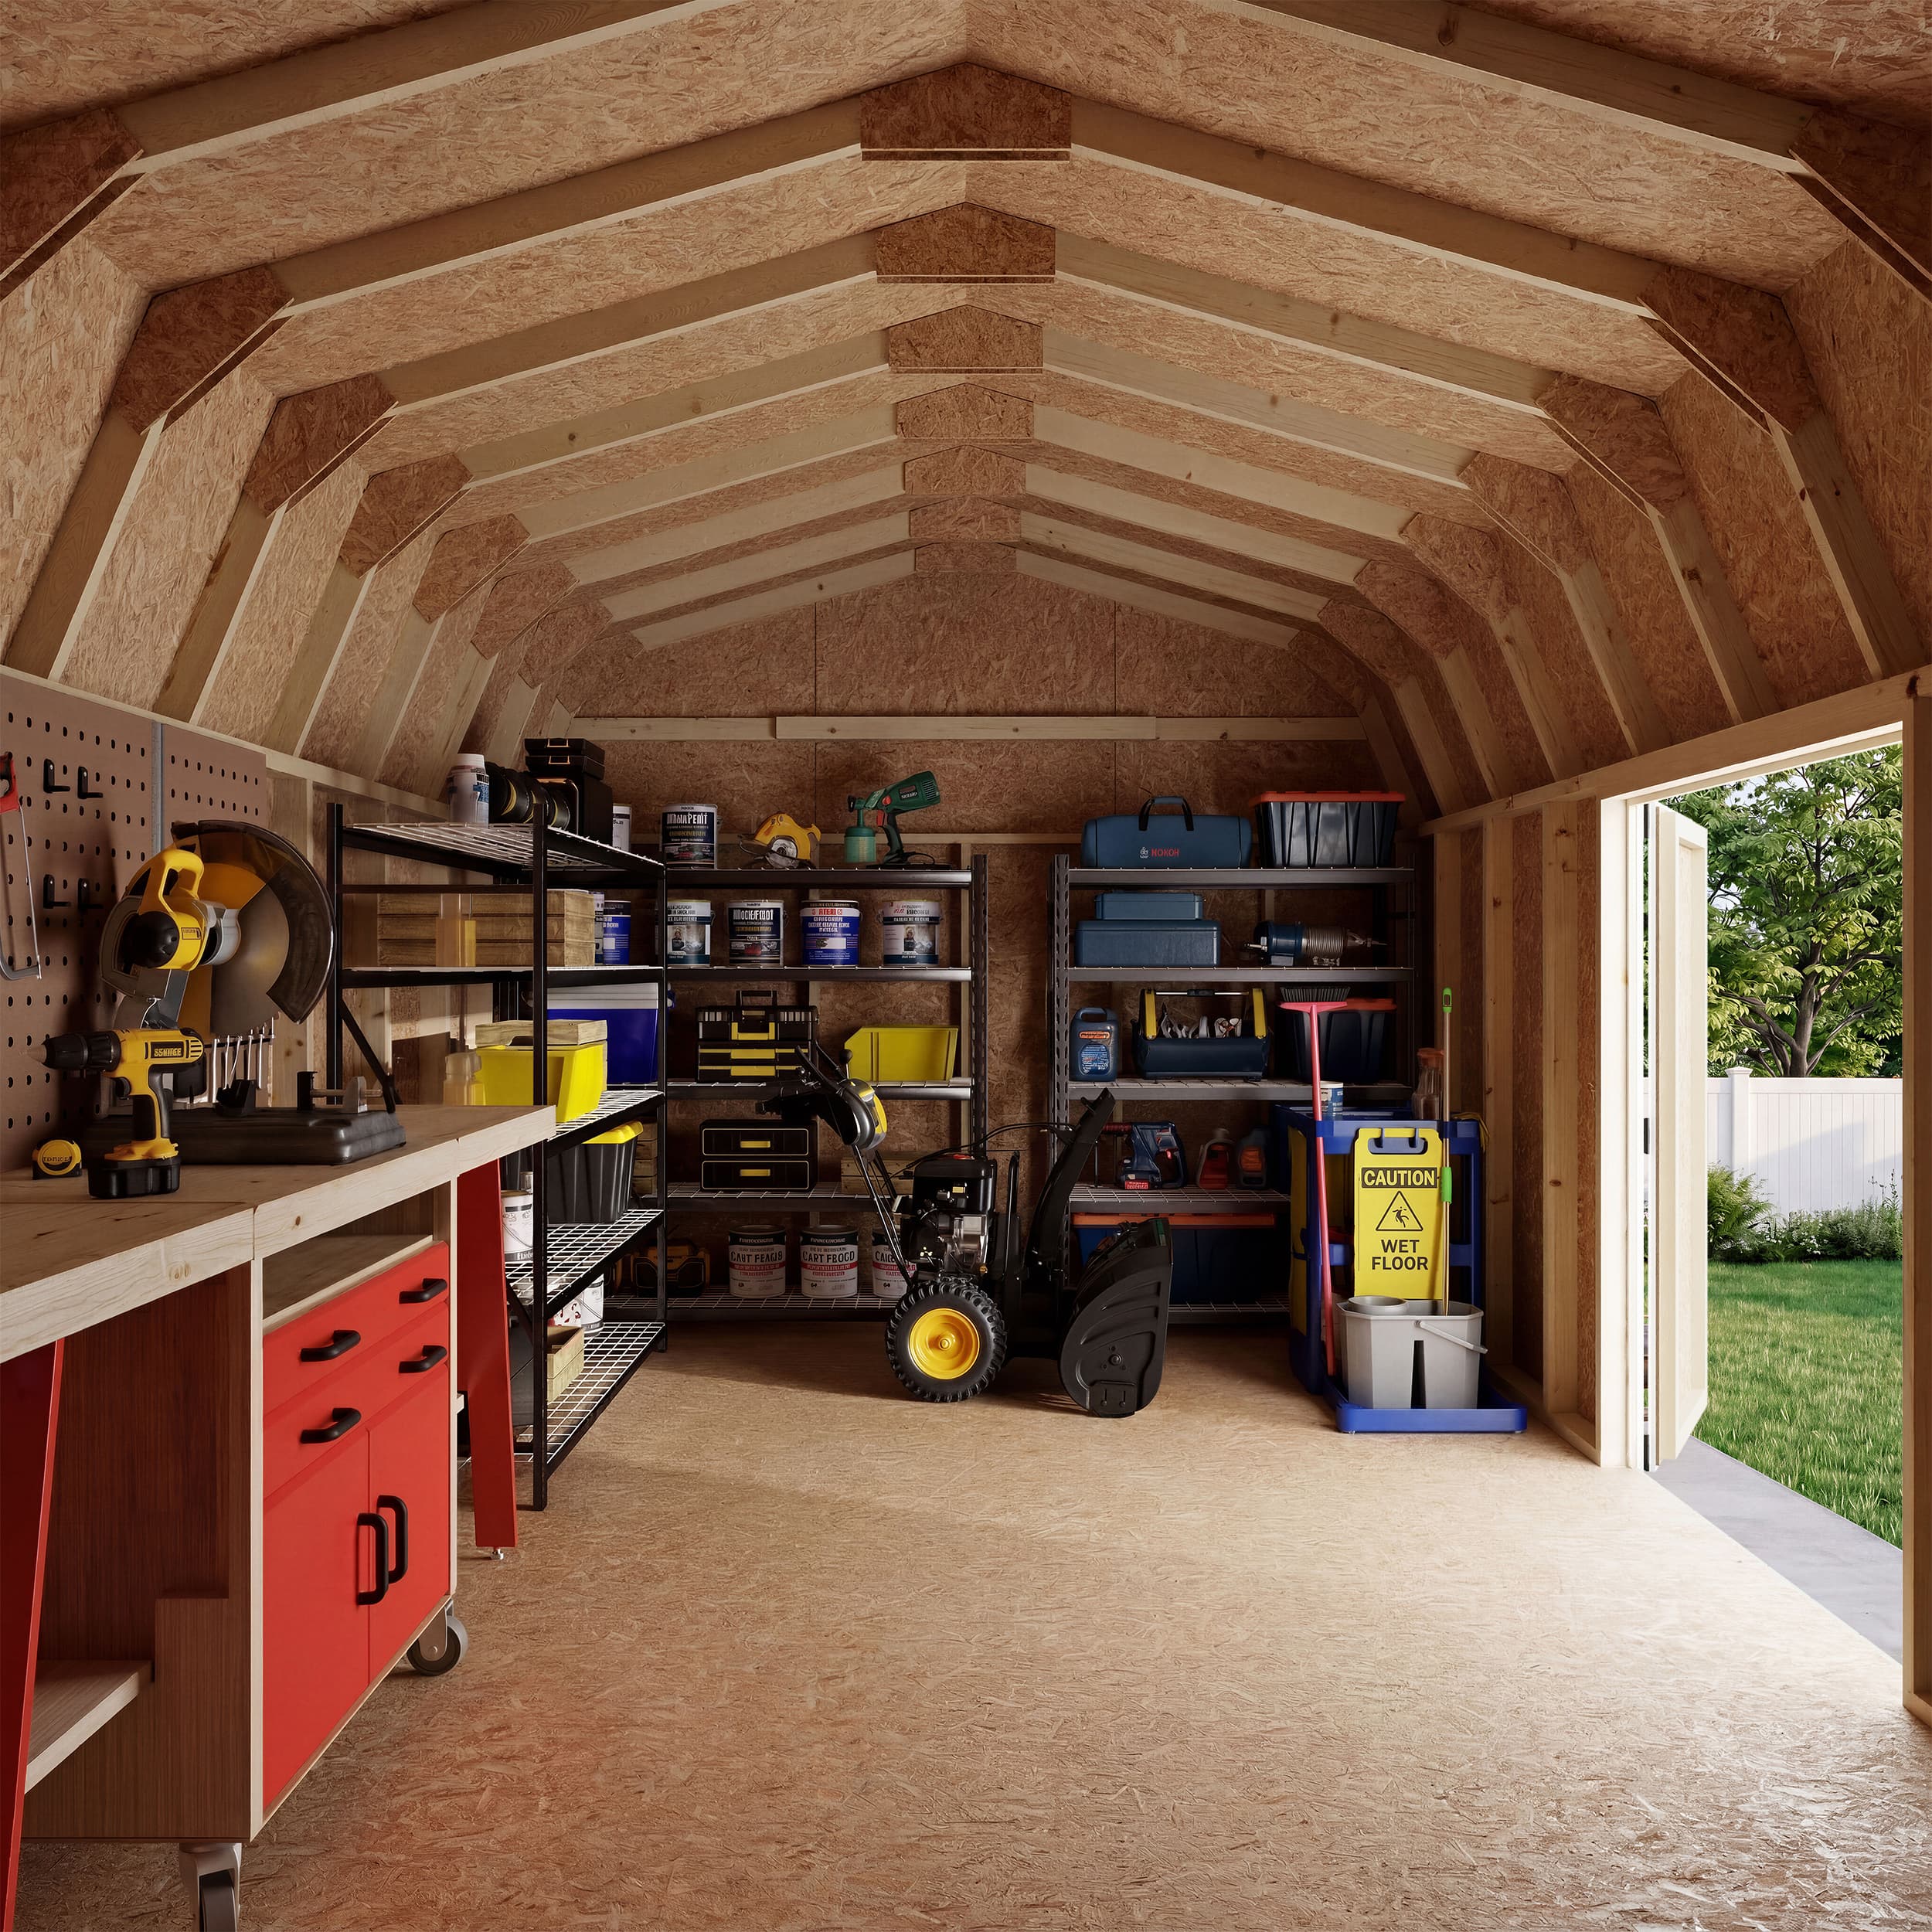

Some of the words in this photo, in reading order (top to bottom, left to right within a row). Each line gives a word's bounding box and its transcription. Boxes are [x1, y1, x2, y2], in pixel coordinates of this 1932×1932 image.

[1363, 1169, 1435, 1186] CAUTION
[1380, 1239, 1420, 1253] WET
[1372, 1256, 1429, 1270] FLOOR
